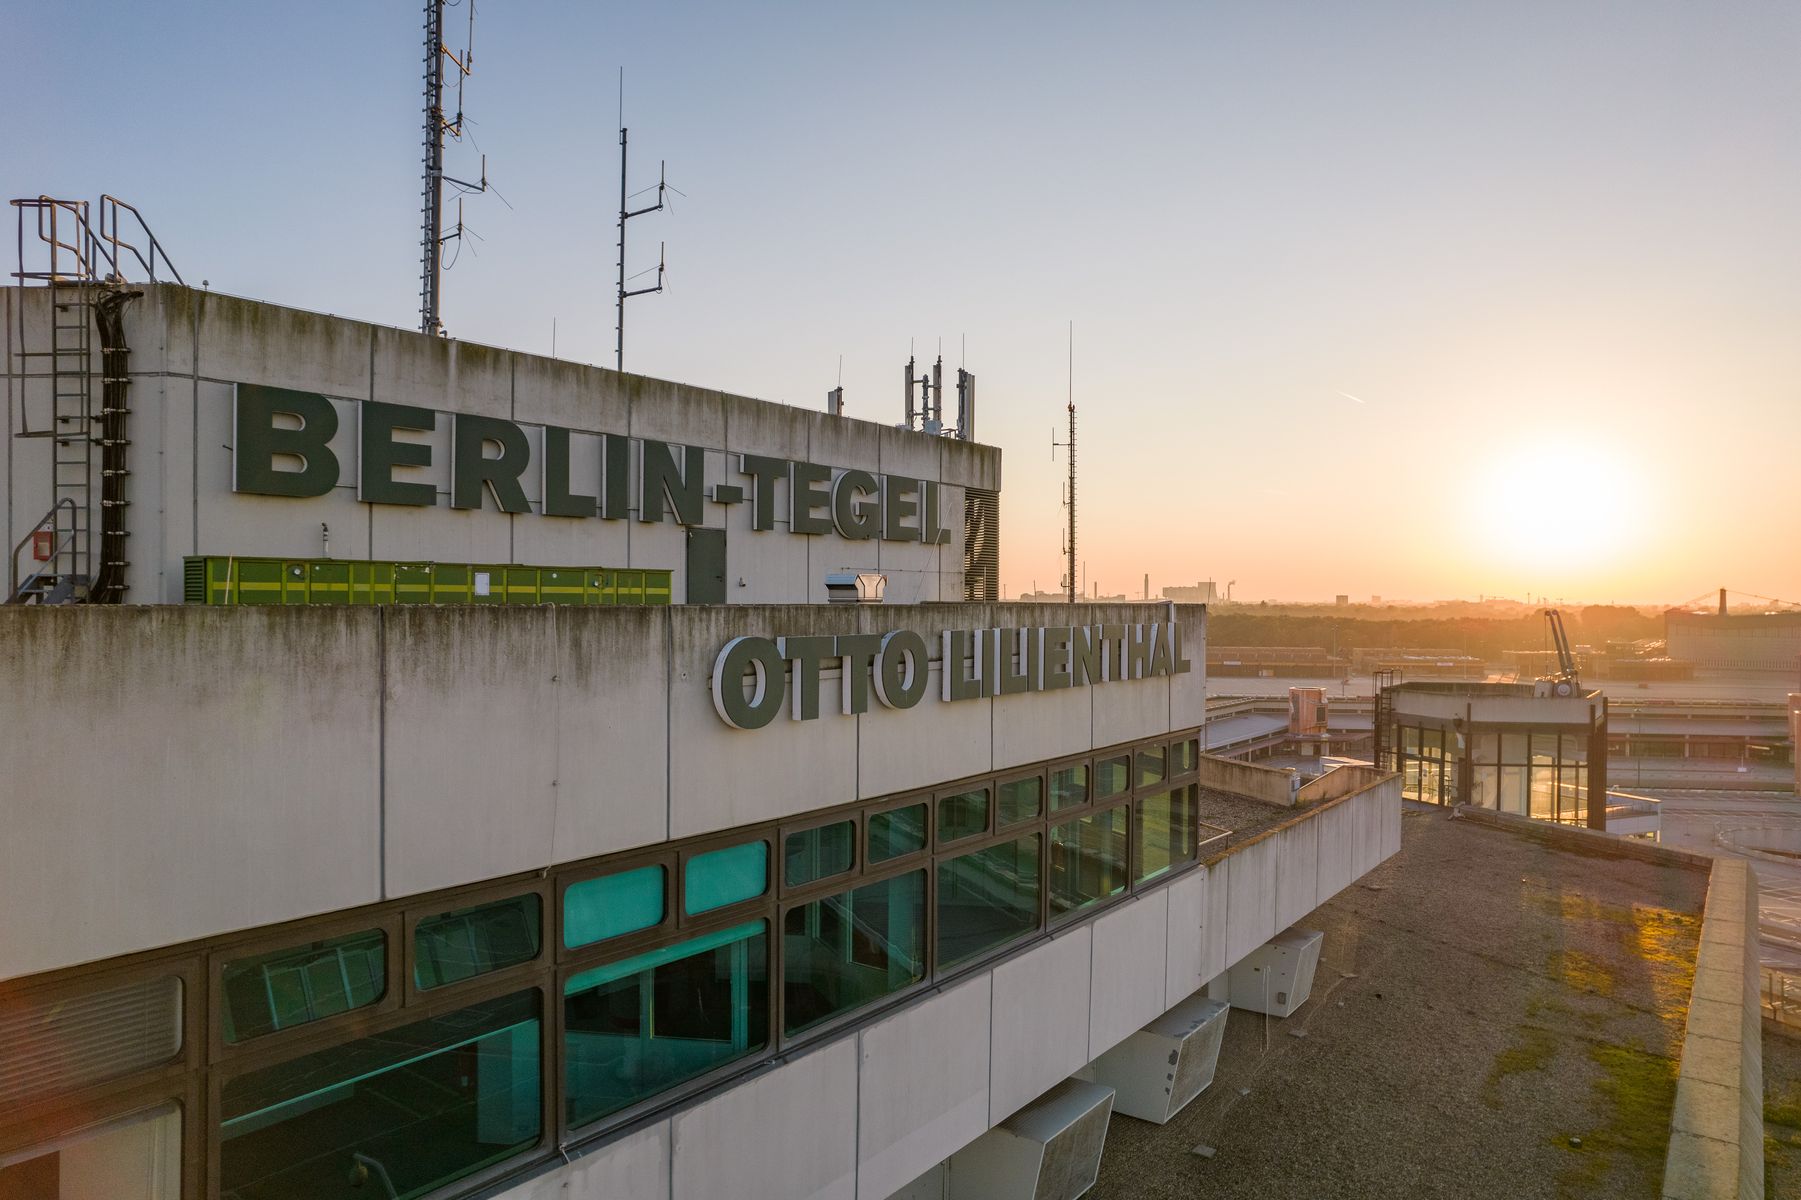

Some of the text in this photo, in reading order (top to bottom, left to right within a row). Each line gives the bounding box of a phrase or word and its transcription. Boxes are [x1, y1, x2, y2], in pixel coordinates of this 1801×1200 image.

[232, 382, 951, 544] BERLIN-TEGEL
[712, 622, 1191, 730] OTTO LILIENTHAL
